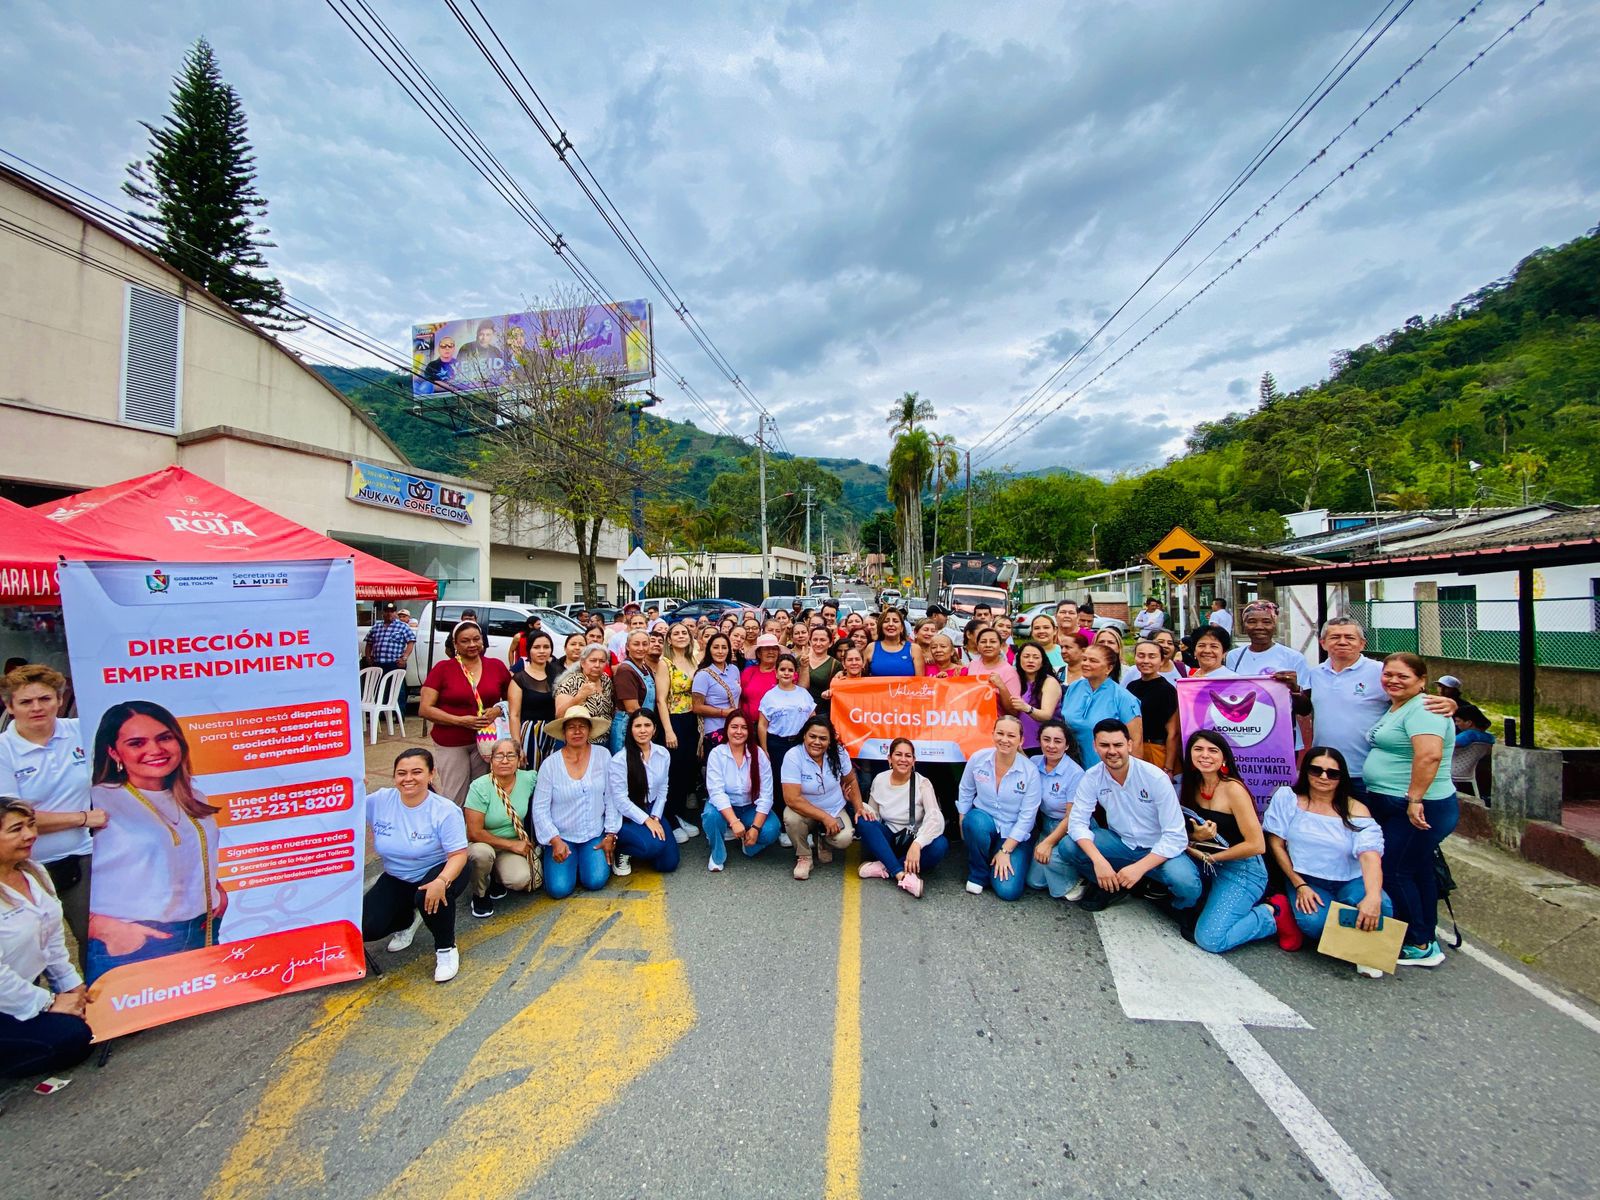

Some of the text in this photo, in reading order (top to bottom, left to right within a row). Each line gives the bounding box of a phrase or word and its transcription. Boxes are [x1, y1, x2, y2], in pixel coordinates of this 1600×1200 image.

[176, 509, 228, 518] TAPA
[403, 499, 469, 520] CONFECCIONA
[165, 516, 258, 537] ROJA
[33, 568, 51, 596] LA
[128, 628, 310, 657] DIRECCIÓN DE
[102, 651, 335, 684] EMPRENDIMIENTO
[188, 706, 342, 731] Nuestra línea está disponible
[849, 708, 977, 727] Gracias DIAN
[200, 732, 228, 744] para
[230, 730, 240, 740] ti:
[242, 726, 278, 738] cursos,
[330, 718, 342, 726] en
[232, 730, 343, 750] asociatividad y ferias
[244, 741, 344, 761] de emprendimiento
[1234, 755, 1286, 764] obernadora
[1264, 764, 1292, 775] MATIZ
[1248, 777, 1258, 785] SU
[1261, 778, 1292, 787] APOYO!
[228, 782, 344, 808] Línea de asesoría
[230, 793, 346, 822] 323-231-8207
[226, 832, 348, 858] Síguenos en nuestras redes
[295, 854, 315, 863] Mujer
[327, 848, 350, 856] Tolima
[111, 942, 346, 1013] ValientES crecer juntas
